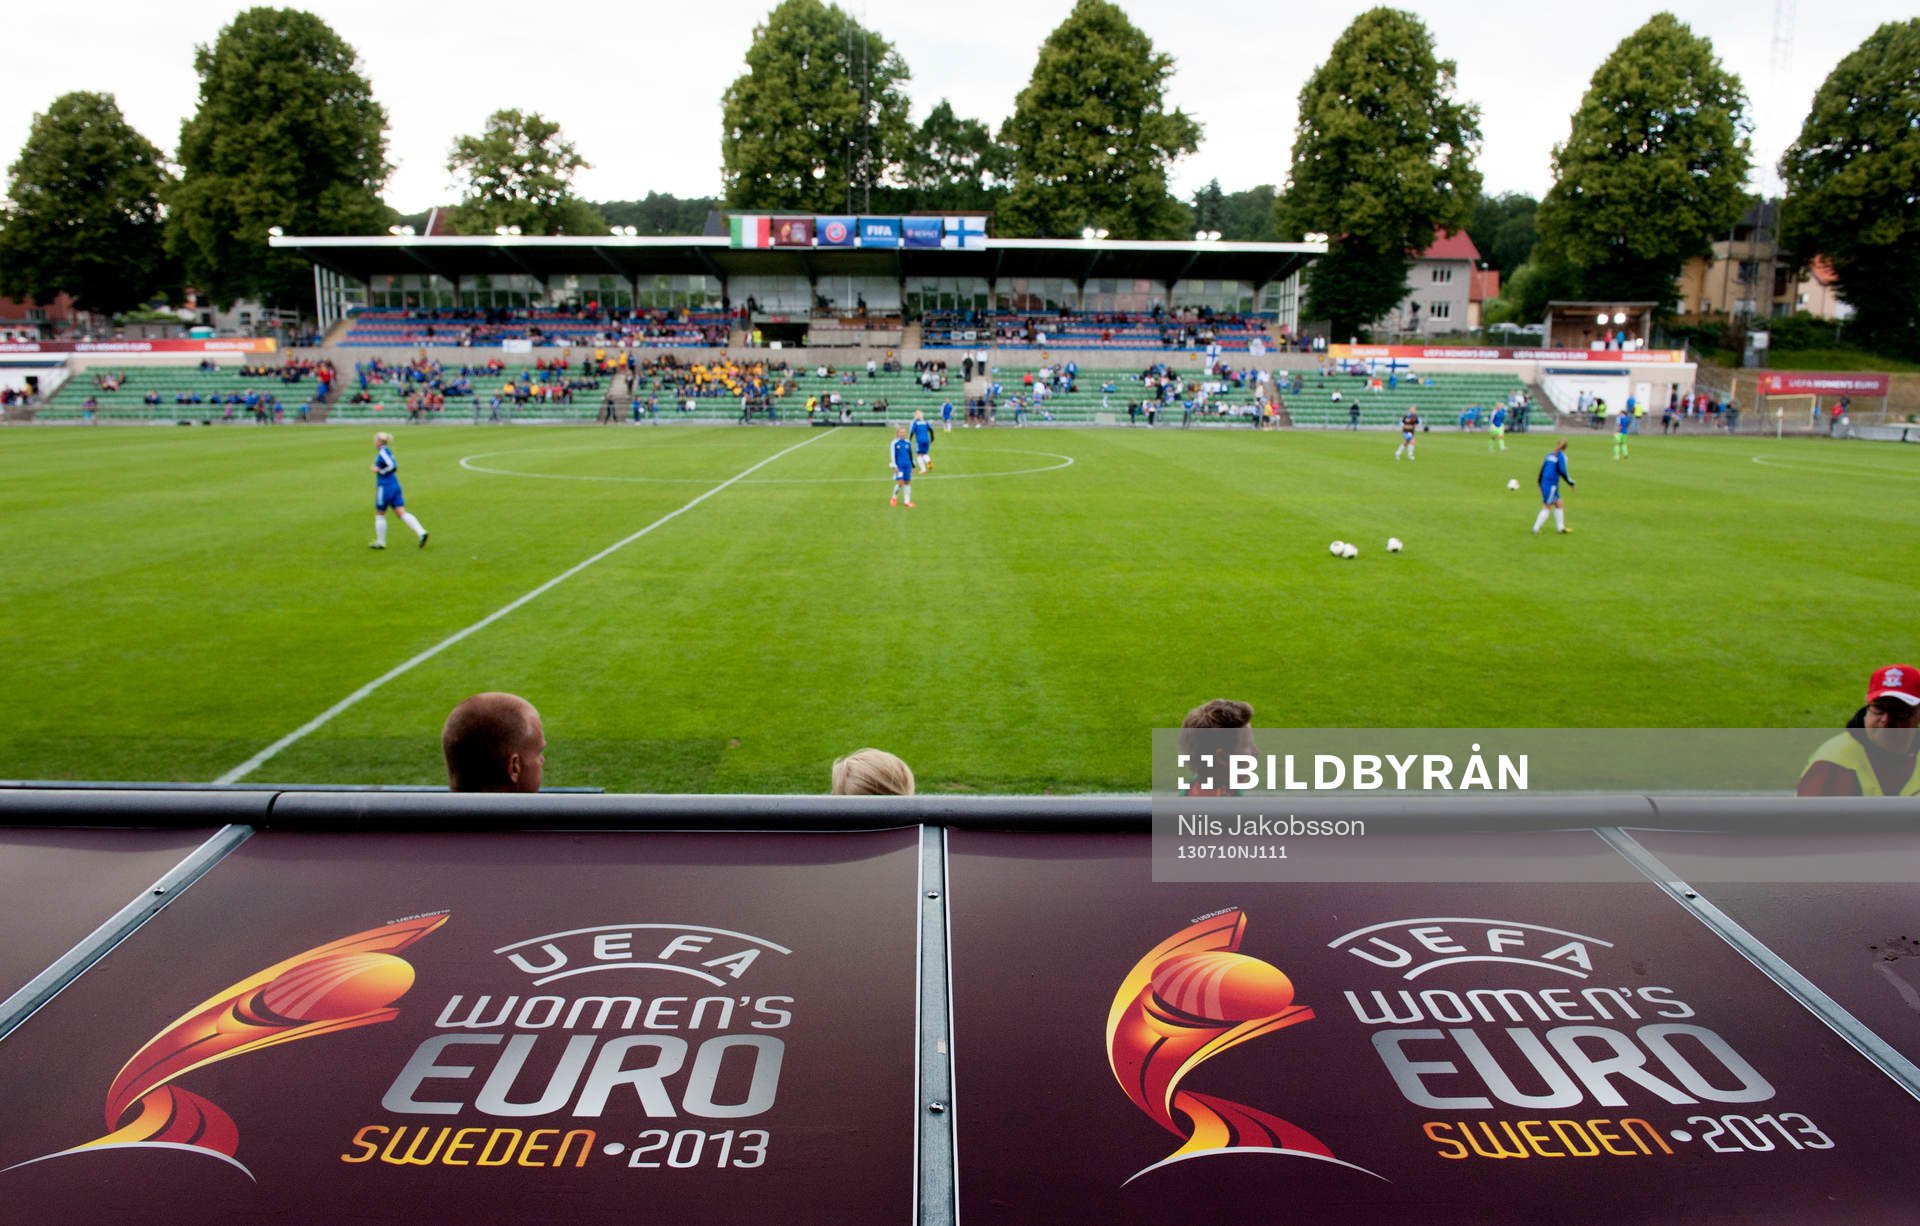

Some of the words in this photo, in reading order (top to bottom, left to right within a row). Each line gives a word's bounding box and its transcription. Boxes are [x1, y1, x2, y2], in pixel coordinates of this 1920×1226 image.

[866, 225, 893, 236] FIFA
[507, 932, 761, 979] UEFA
[1348, 926, 1593, 971] UEFA
[434, 995, 795, 1030] WOMEN'S
[1343, 986, 1696, 1025] WOMEN'S
[381, 1033, 785, 1118] EURO
[1371, 1023, 1776, 1110] EURO
